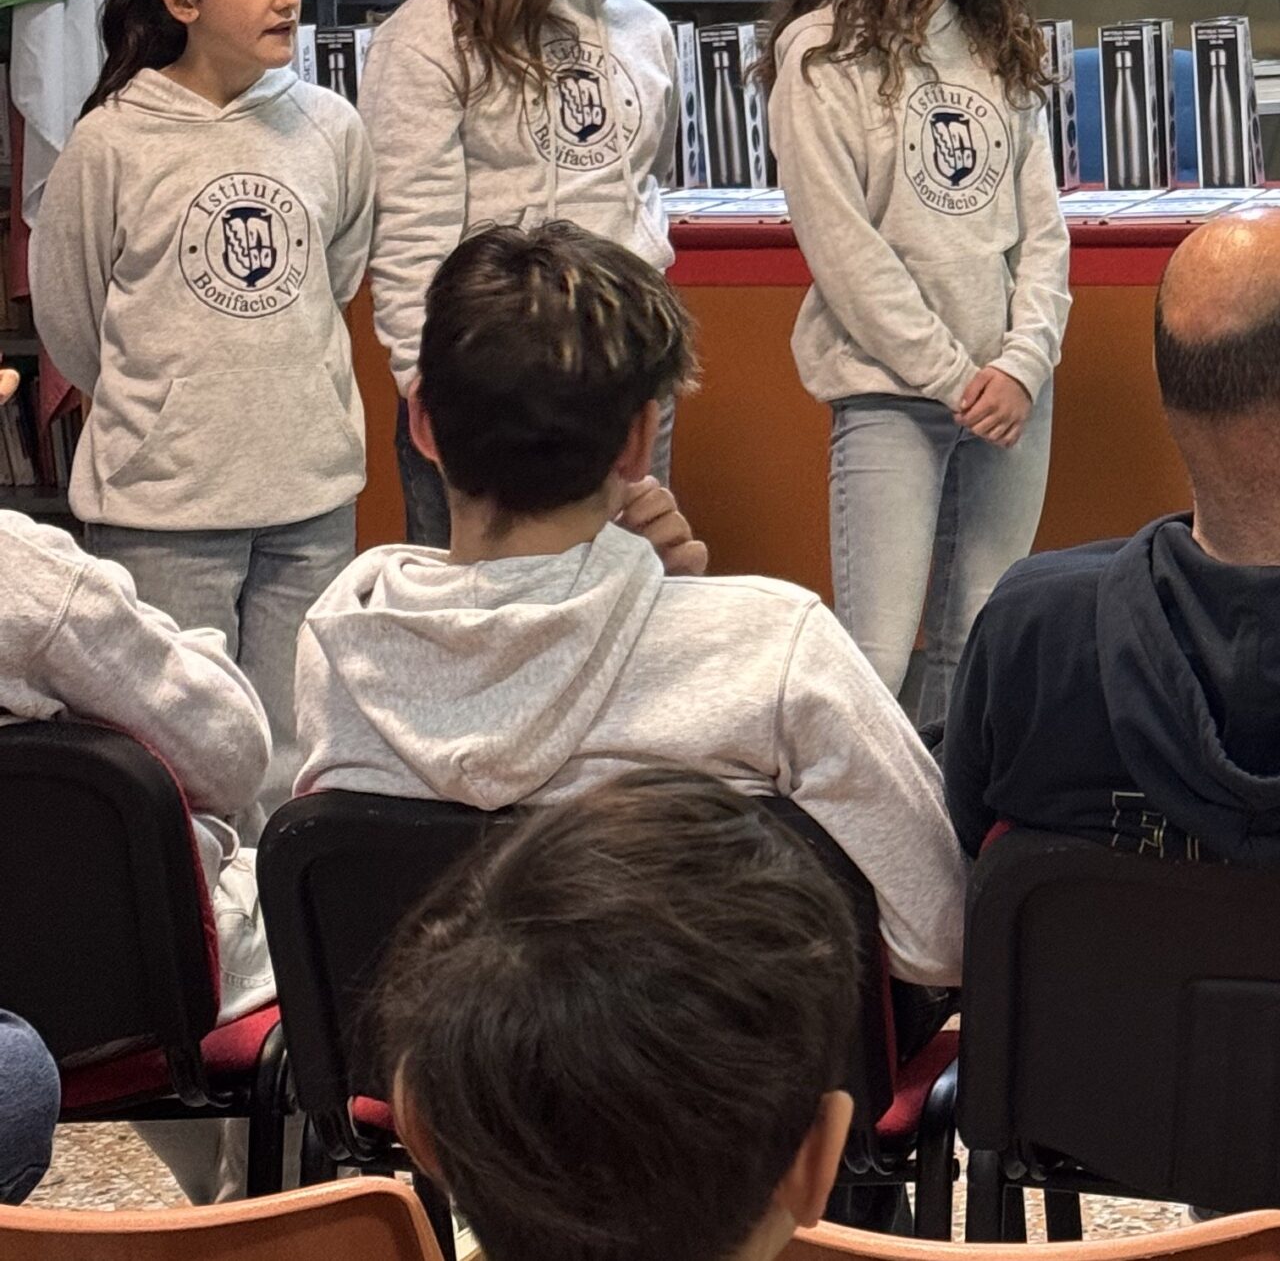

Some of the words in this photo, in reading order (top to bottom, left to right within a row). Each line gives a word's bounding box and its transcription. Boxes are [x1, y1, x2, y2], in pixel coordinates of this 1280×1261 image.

[908, 85, 988, 120] Istituto
[534, 124, 604, 166] Boifacio
[194, 176, 293, 217] Istituto
[912, 169, 978, 210] Bonifacio
[193, 271, 277, 313] Bonifacio
